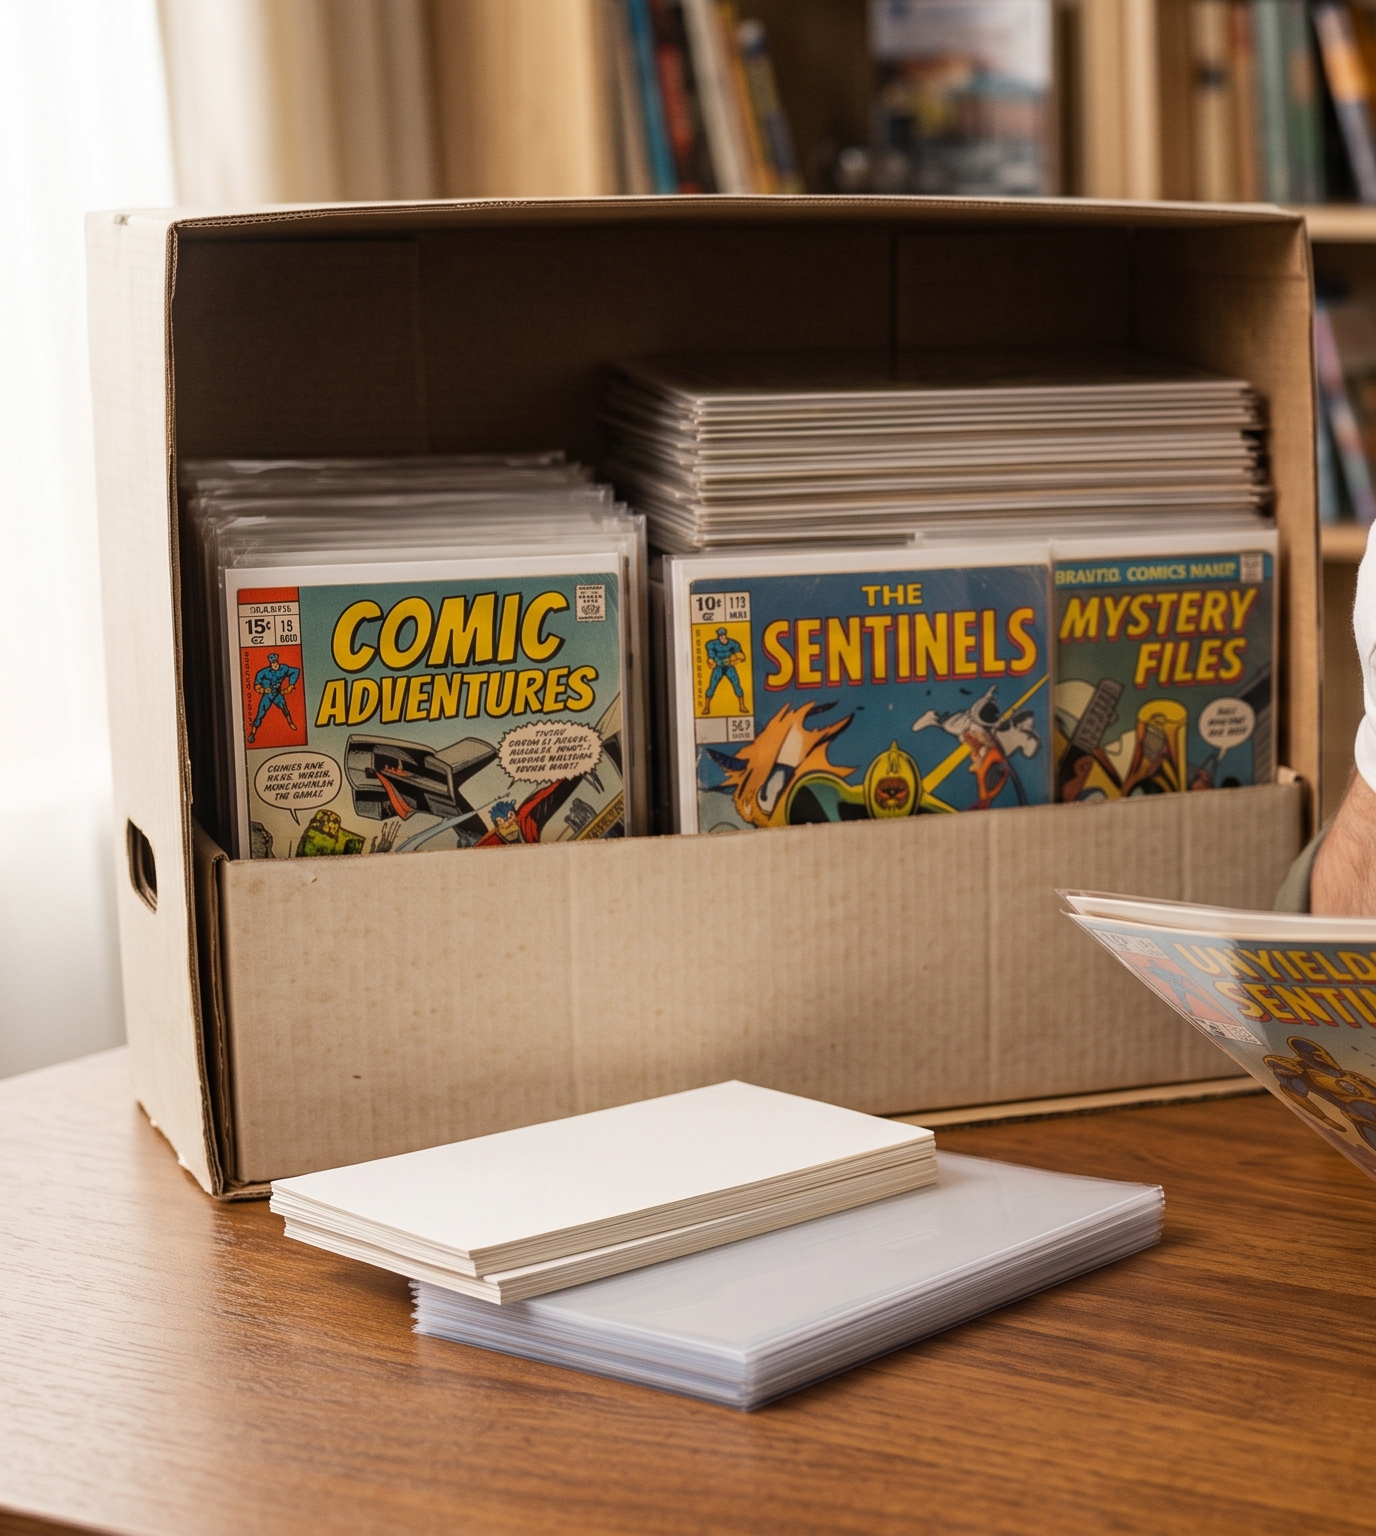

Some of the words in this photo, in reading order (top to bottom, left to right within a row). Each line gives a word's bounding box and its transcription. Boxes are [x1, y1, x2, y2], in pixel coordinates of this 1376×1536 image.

[861, 583, 923, 607] THE
[1126, 564, 1187, 582] COMICS
[332, 591, 571, 673] COMIC
[1058, 588, 1258, 643] MYSTERY
[762, 607, 1038, 692] SENTINELS
[1132, 638, 1247, 688] FILES
[315, 666, 599, 728] ADVENTURES
